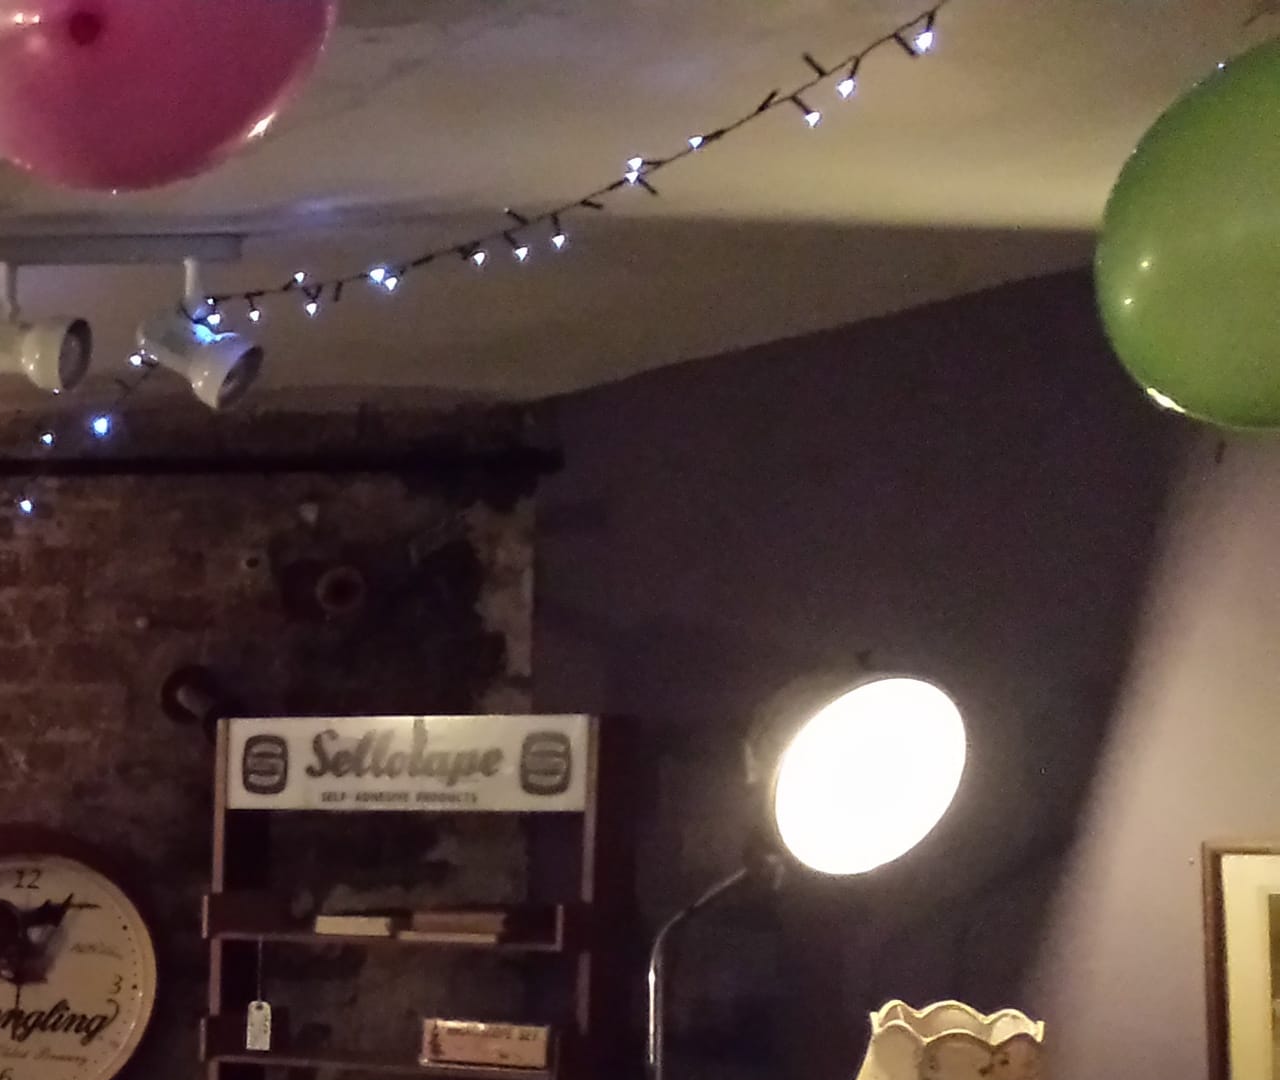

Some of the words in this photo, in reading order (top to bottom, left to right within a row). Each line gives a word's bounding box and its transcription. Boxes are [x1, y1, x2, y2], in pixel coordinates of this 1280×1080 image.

[306, 719, 504, 787] Sellotape
[321, 792, 346, 802] SELF
[13, 869, 40, 890] 12
[112, 976, 123, 995] 3
